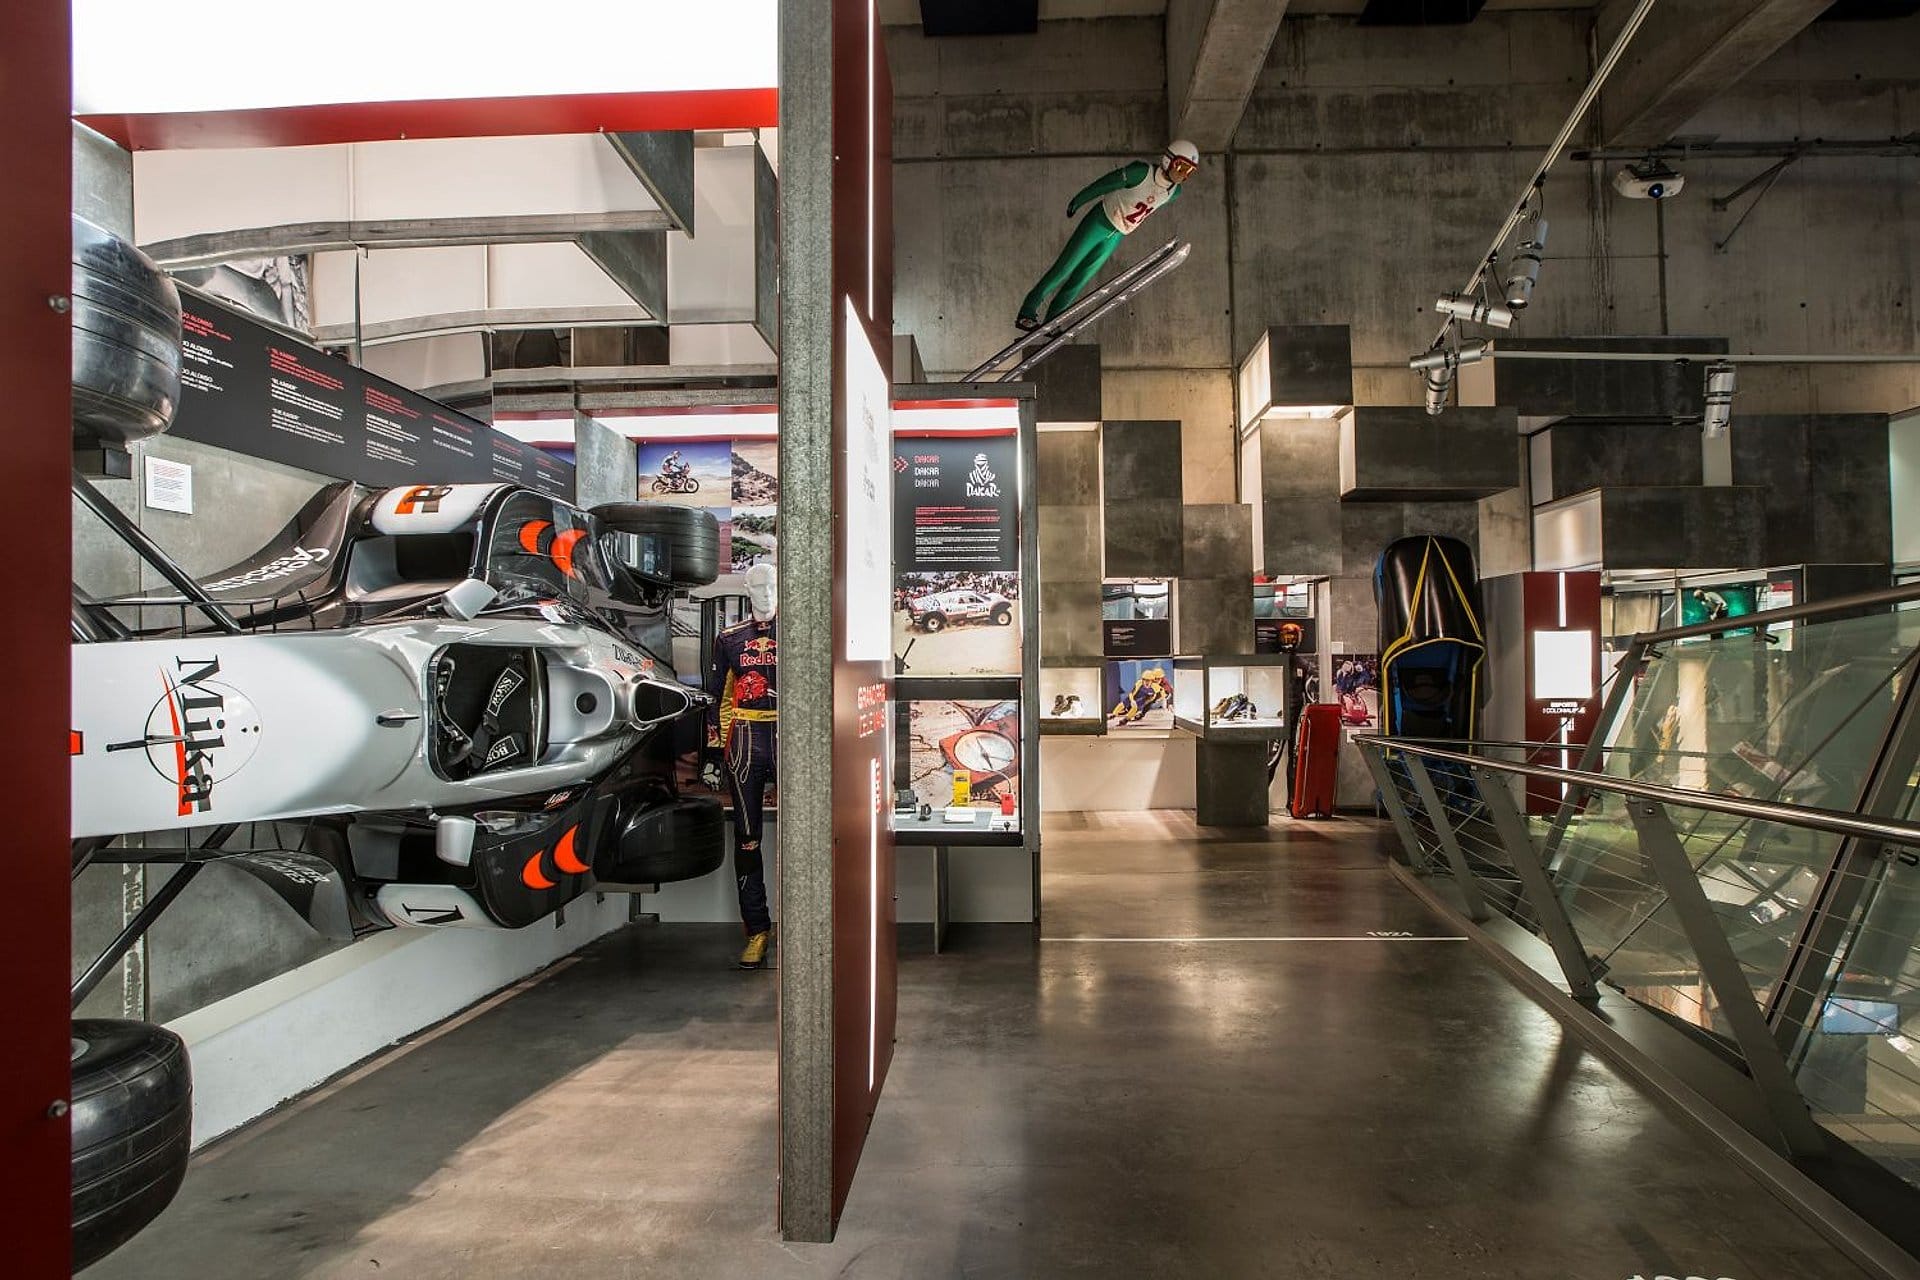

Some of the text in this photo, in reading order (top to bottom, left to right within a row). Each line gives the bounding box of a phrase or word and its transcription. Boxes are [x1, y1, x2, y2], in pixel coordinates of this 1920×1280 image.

[914, 455, 940, 464] DAKAR
[914, 466, 940, 476] DAKAR
[914, 478, 940, 488] DAKAR
[966, 482, 1000, 497] DAKAR
[740, 653, 778, 667] Red Bu
[175, 654, 226, 806] Mika
[486, 745, 510, 763] BOS
